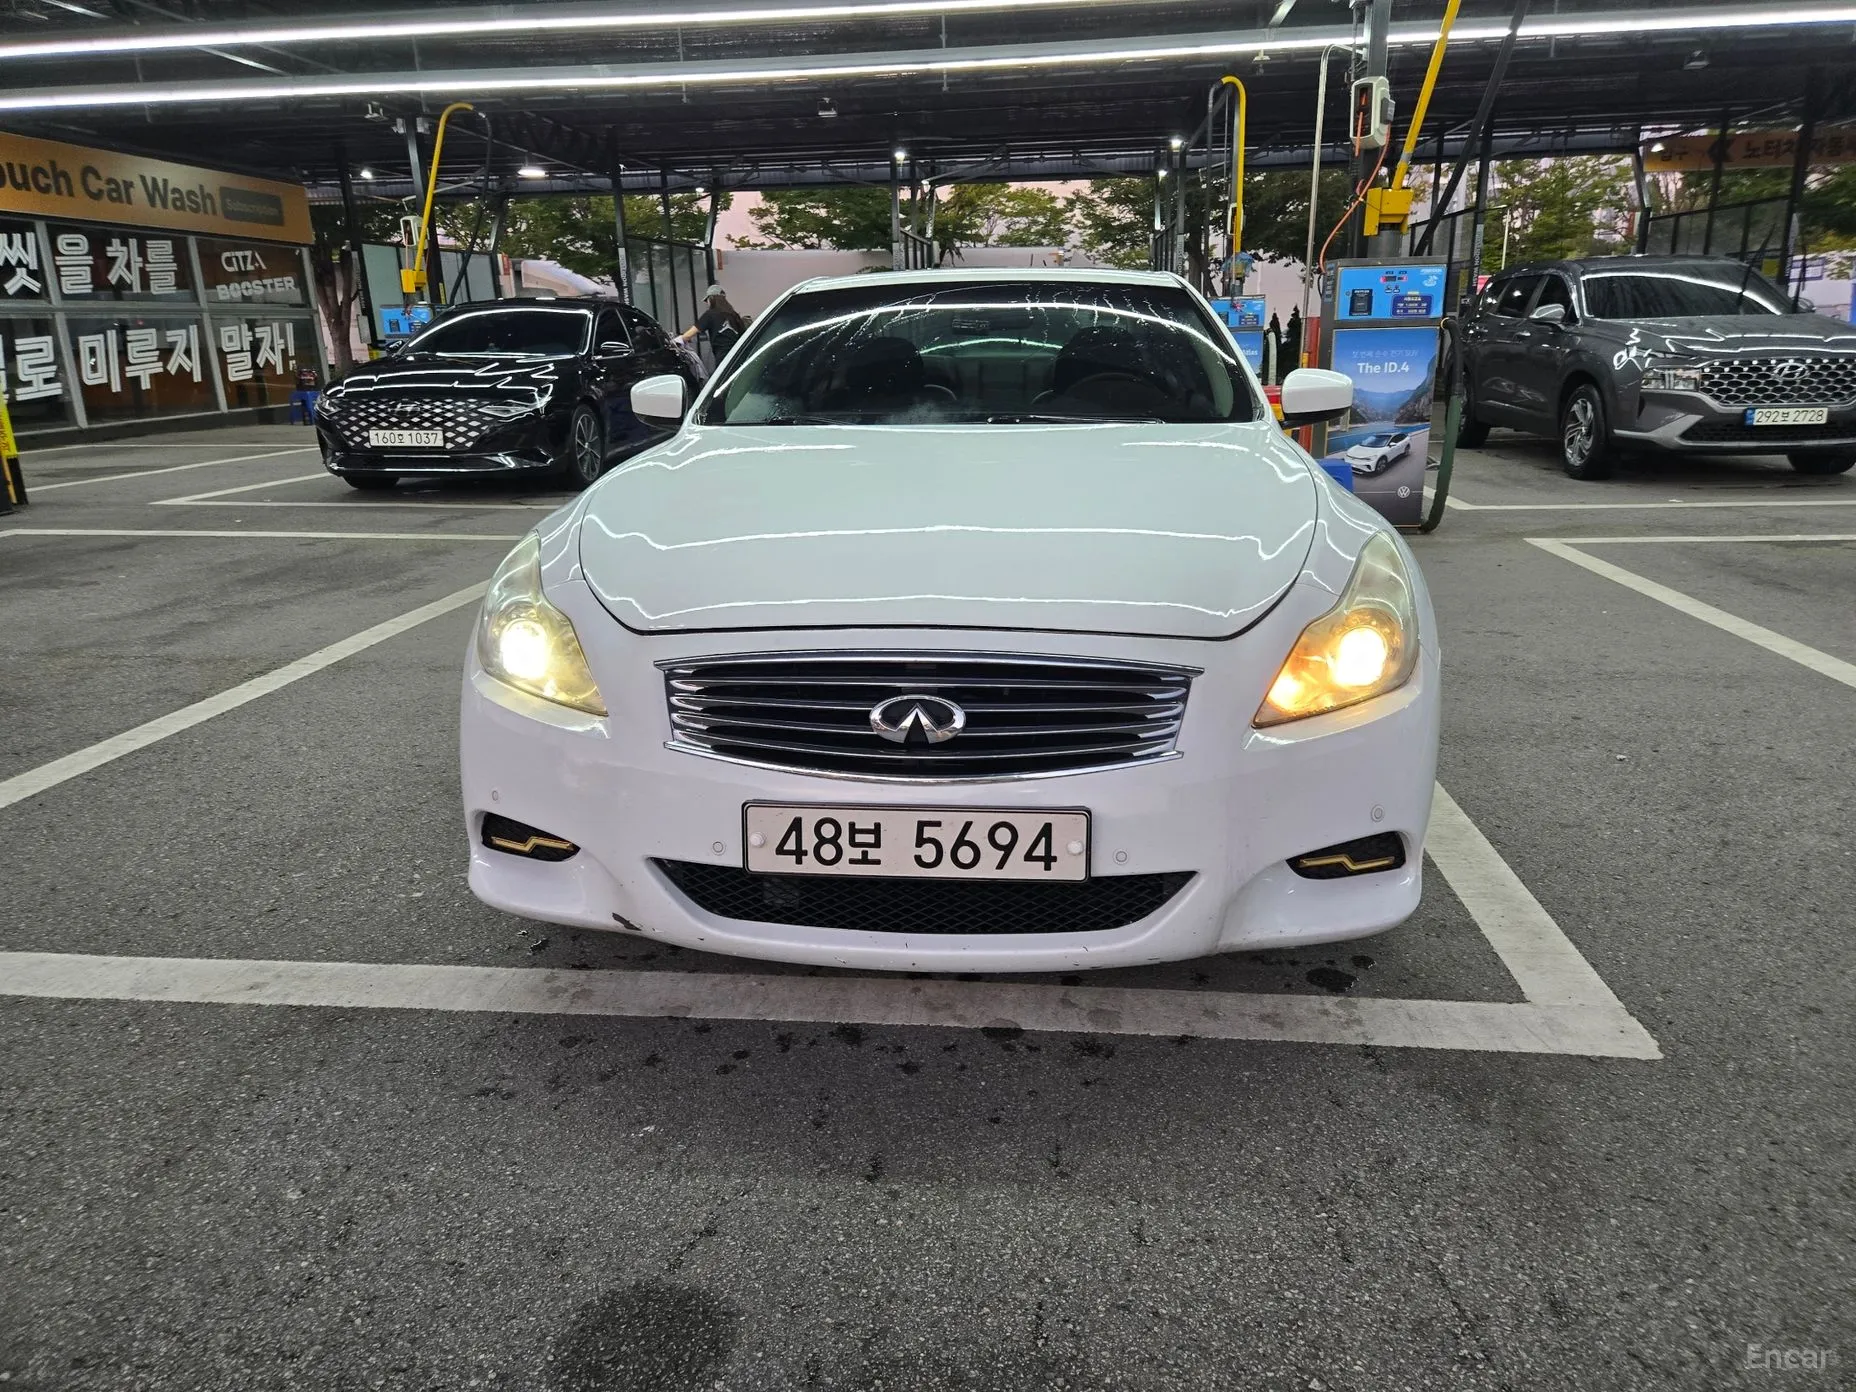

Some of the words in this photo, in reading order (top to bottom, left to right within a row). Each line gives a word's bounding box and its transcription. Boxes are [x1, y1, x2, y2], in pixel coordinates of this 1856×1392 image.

[81, 165, 135, 206] Car
[138, 173, 218, 217] Wash
[105, 238, 178, 295] 차를
[216, 276, 296, 300] BOOSTER
[78, 324, 203, 393] 미루지
[220, 322, 296, 382] 말자!
[1357, 362, 1381, 374] The
[1383, 360, 1410, 374] ID.4
[1756, 409, 1790, 423] 292보
[1792, 409, 1824, 422] 2728
[407, 431, 438, 445] 1037
[775, 816, 882, 866] 48보
[913, 820, 1058, 872] 5694
